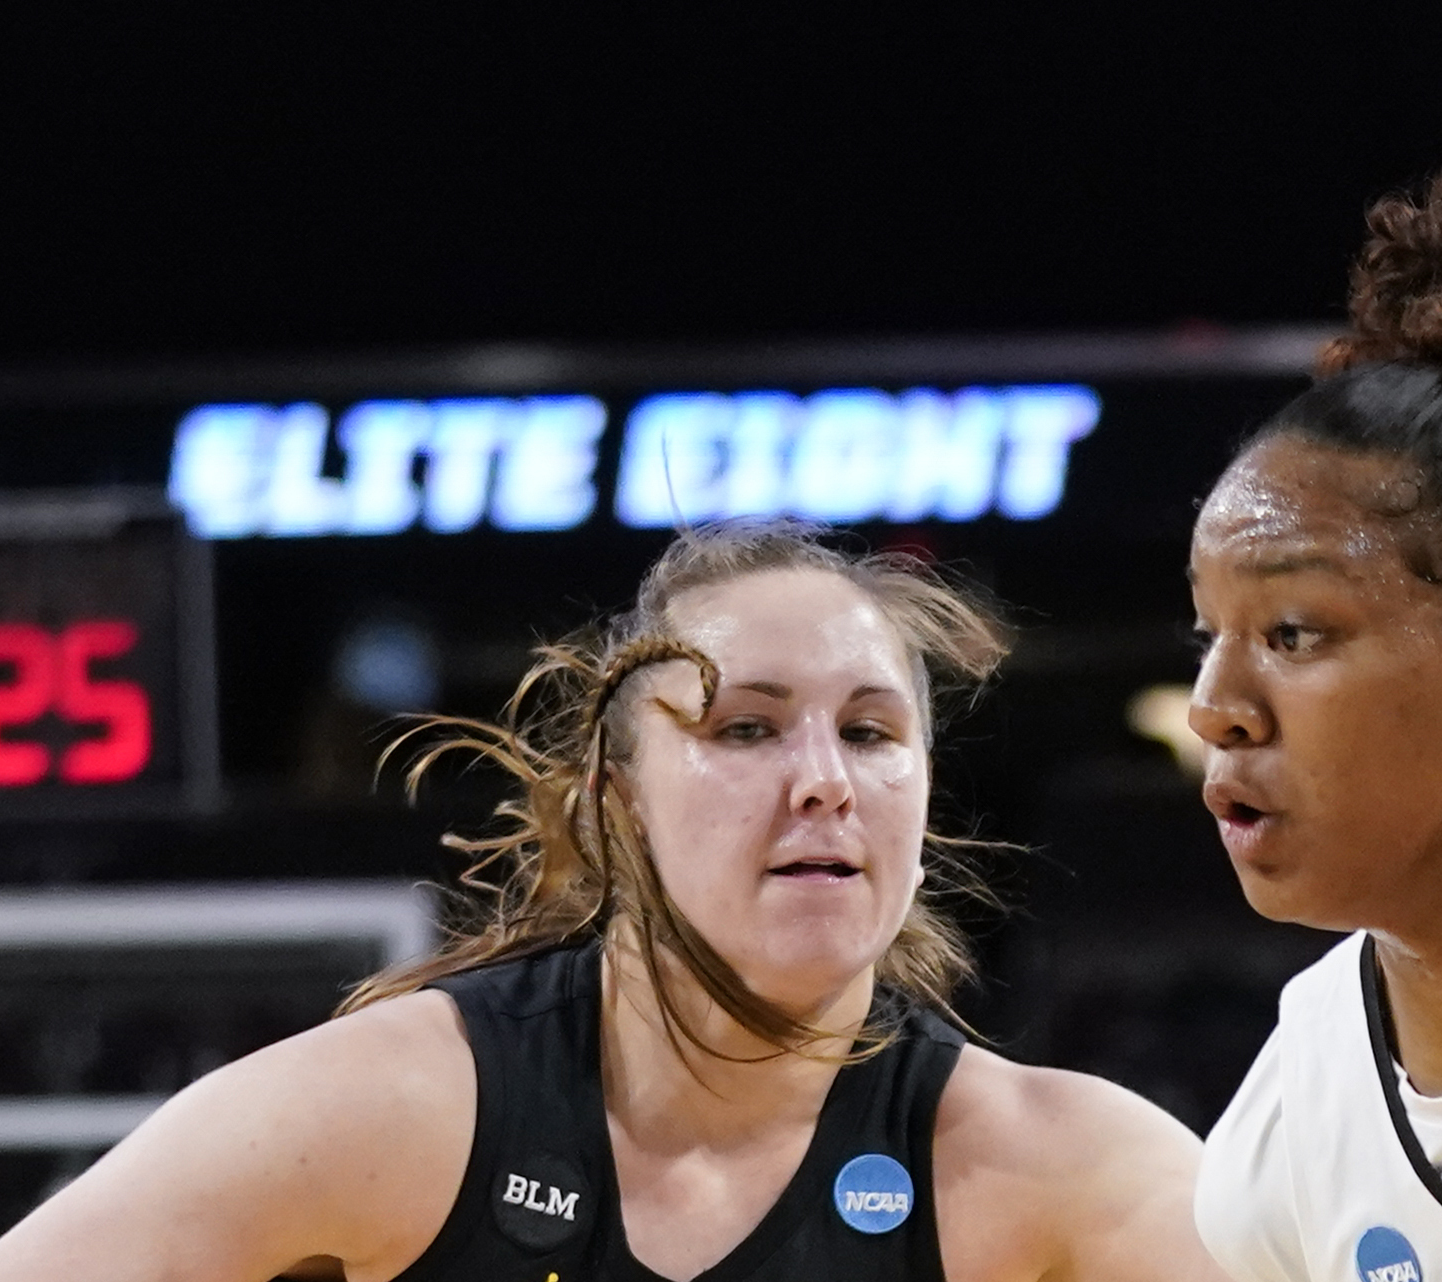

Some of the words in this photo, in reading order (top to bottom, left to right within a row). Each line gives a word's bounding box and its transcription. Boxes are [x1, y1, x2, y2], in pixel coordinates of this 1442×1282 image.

[172, 396, 604, 540] ELITE
[614, 384, 1098, 526] EIGHT
[502, 1173, 581, 1221] BLM
[844, 1191, 910, 1213] NCAA
